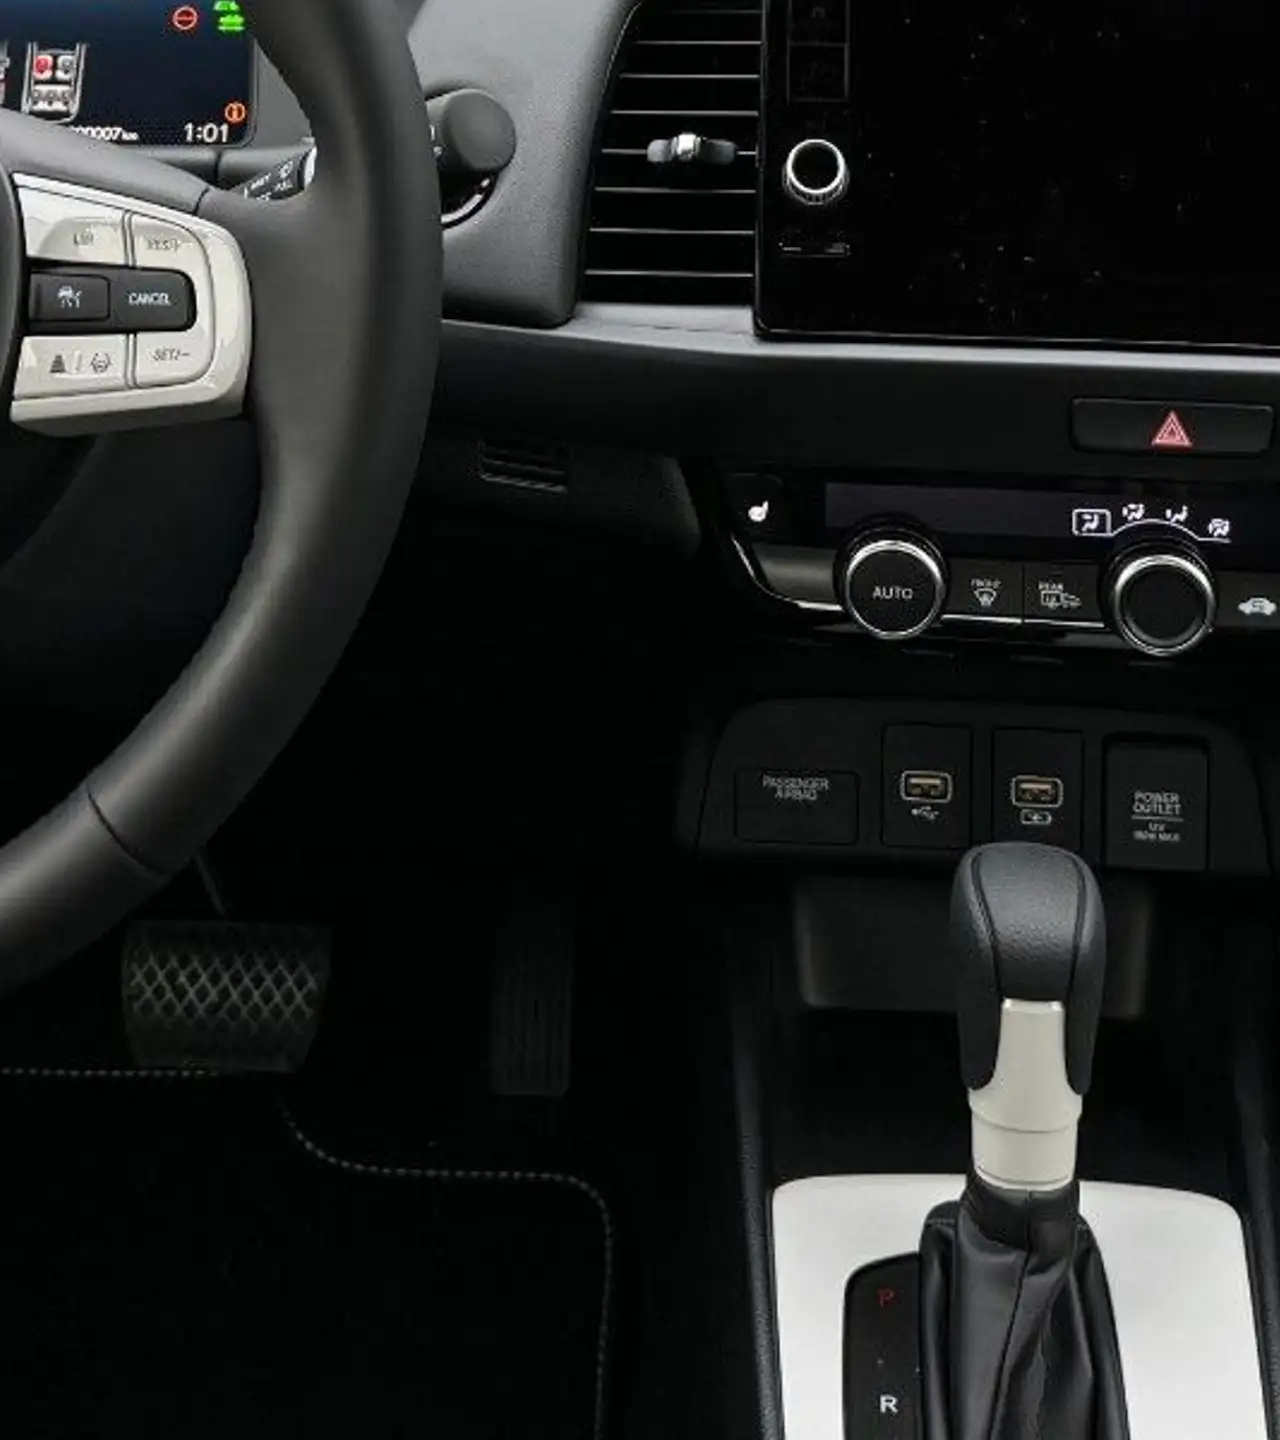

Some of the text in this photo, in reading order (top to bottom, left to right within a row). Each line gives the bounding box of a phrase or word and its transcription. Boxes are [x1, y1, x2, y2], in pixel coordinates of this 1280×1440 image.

[184, 123, 228, 142] 1:01
[128, 292, 171, 306] CANCEL
[872, 585, 914, 600] AUTO
[1133, 802, 1182, 814] OUTLET
[879, 1394, 898, 1413] R
